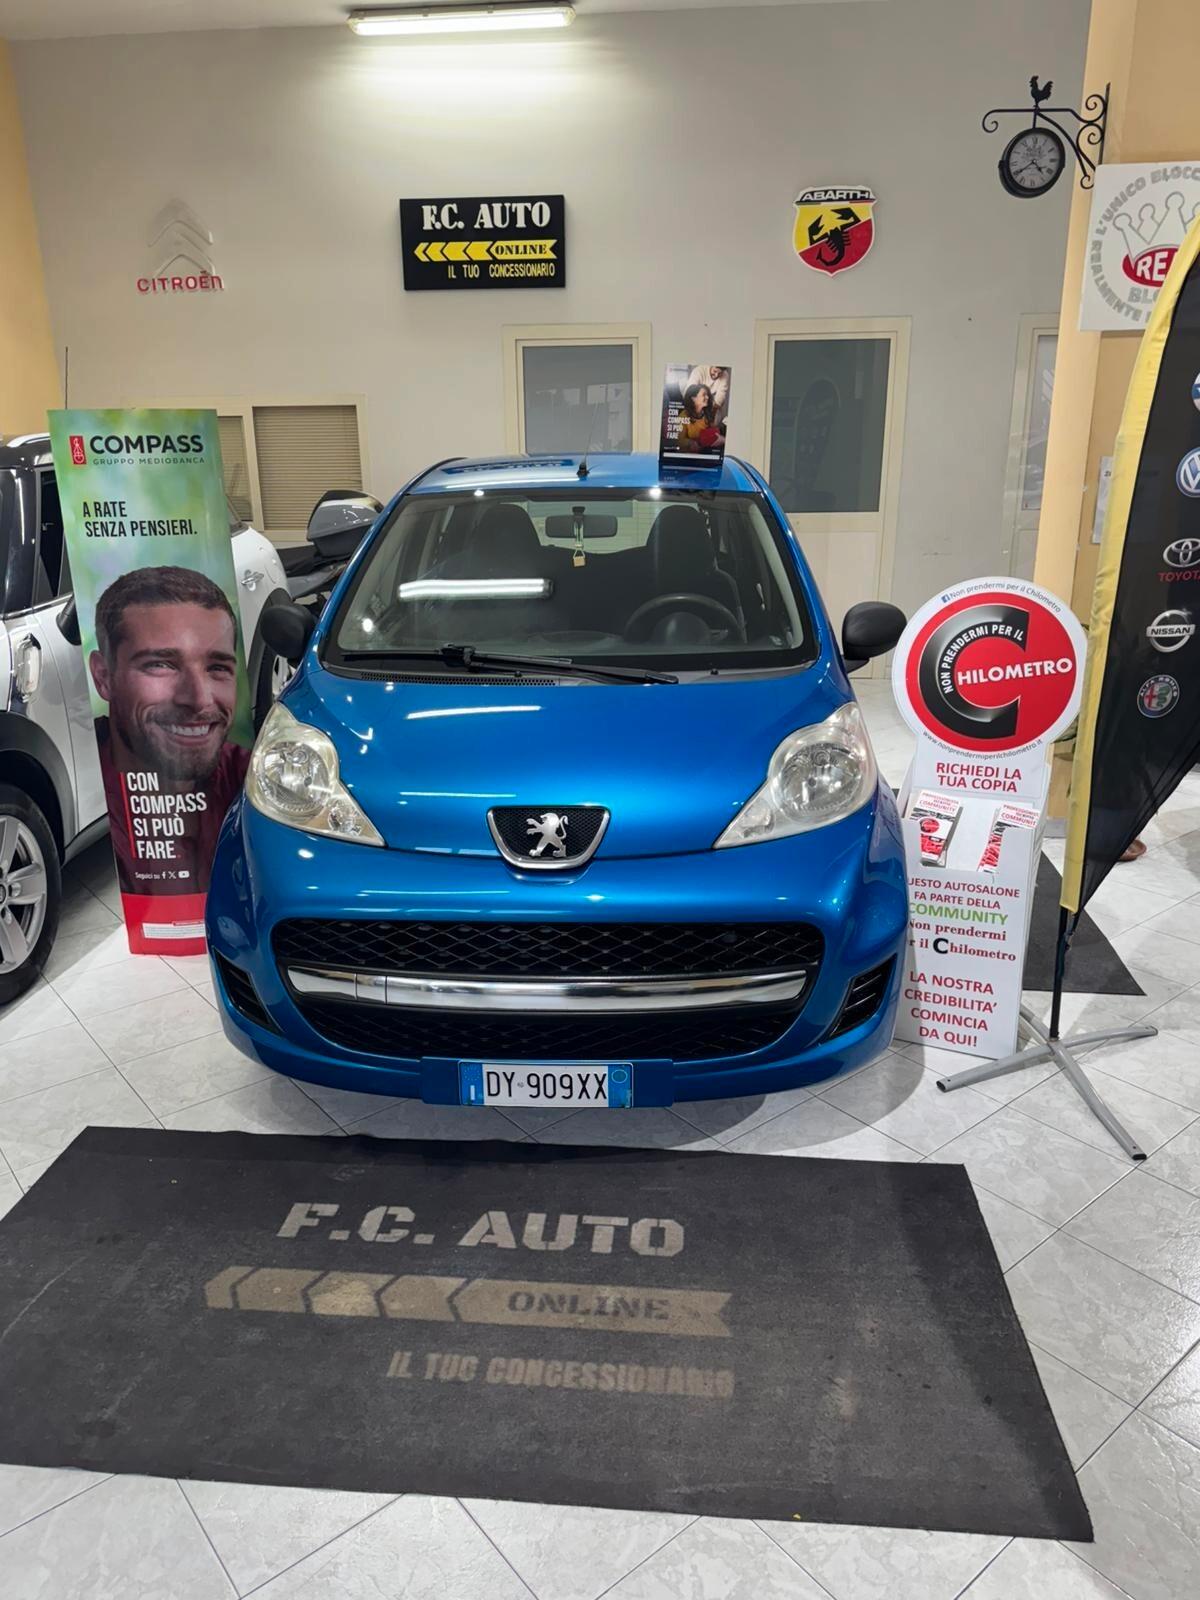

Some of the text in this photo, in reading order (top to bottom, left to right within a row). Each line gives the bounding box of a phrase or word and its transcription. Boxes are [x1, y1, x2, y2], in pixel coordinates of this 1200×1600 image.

[802, 190, 870, 201] ABARTH
[1095, 165, 1200, 237] L'UNICO BLOCC
[422, 201, 551, 230] F.C. AUTO
[494, 243, 548, 256] ONLINE
[448, 263, 556, 279] IL TUO CONCESSIONARIO
[1136, 251, 1176, 282] RE
[1090, 240, 1143, 322] REALMENTE
[89, 434, 204, 454] COMPASS
[93, 457, 205, 465] GRUPPO MEDIOBANCA
[83, 501, 127, 517] A RATE
[85, 519, 198, 537] SENZA PENSIERI.
[950, 588, 966, 599] Non
[967, 583, 1005, 595] prendermi
[1006, 583, 1019, 591] per
[1026, 587, 1062, 613] Chilometro
[1150, 627, 1191, 636] NISSAN
[941, 624, 1024, 694] NON PRENDERMI PER IL
[126, 771, 160, 791] CON
[935, 763, 1022, 780] RICHIEDI LA
[937, 775, 1018, 793] TUA COPIA
[130, 792, 208, 815] COMPASS
[134, 814, 185, 837] SI PUÒ
[908, 877, 1020, 898] UESTO AUTOSALONE
[914, 891, 1001, 909] FA PARTE DELLA
[909, 902, 1008, 925] COMMUNITY
[935, 926, 1006, 941] prendermi
[919, 938, 929, 949] il
[933, 937, 1017, 962] Chilometro
[910, 971, 994, 995] LA NOSTRA
[904, 988, 998, 1013] CREDIBILITA'
[910, 1007, 988, 1031] COMINCIA
[919, 1026, 977, 1047] DA QUI!
[486, 1071, 515, 1098] DY
[527, 1073, 608, 1100] 909XX
[276, 1202, 685, 1257] F.C. AUTO
[508, 1289, 670, 1320] ONLINE
[387, 1350, 736, 1400] IL TUO CONCESSIONARIO
